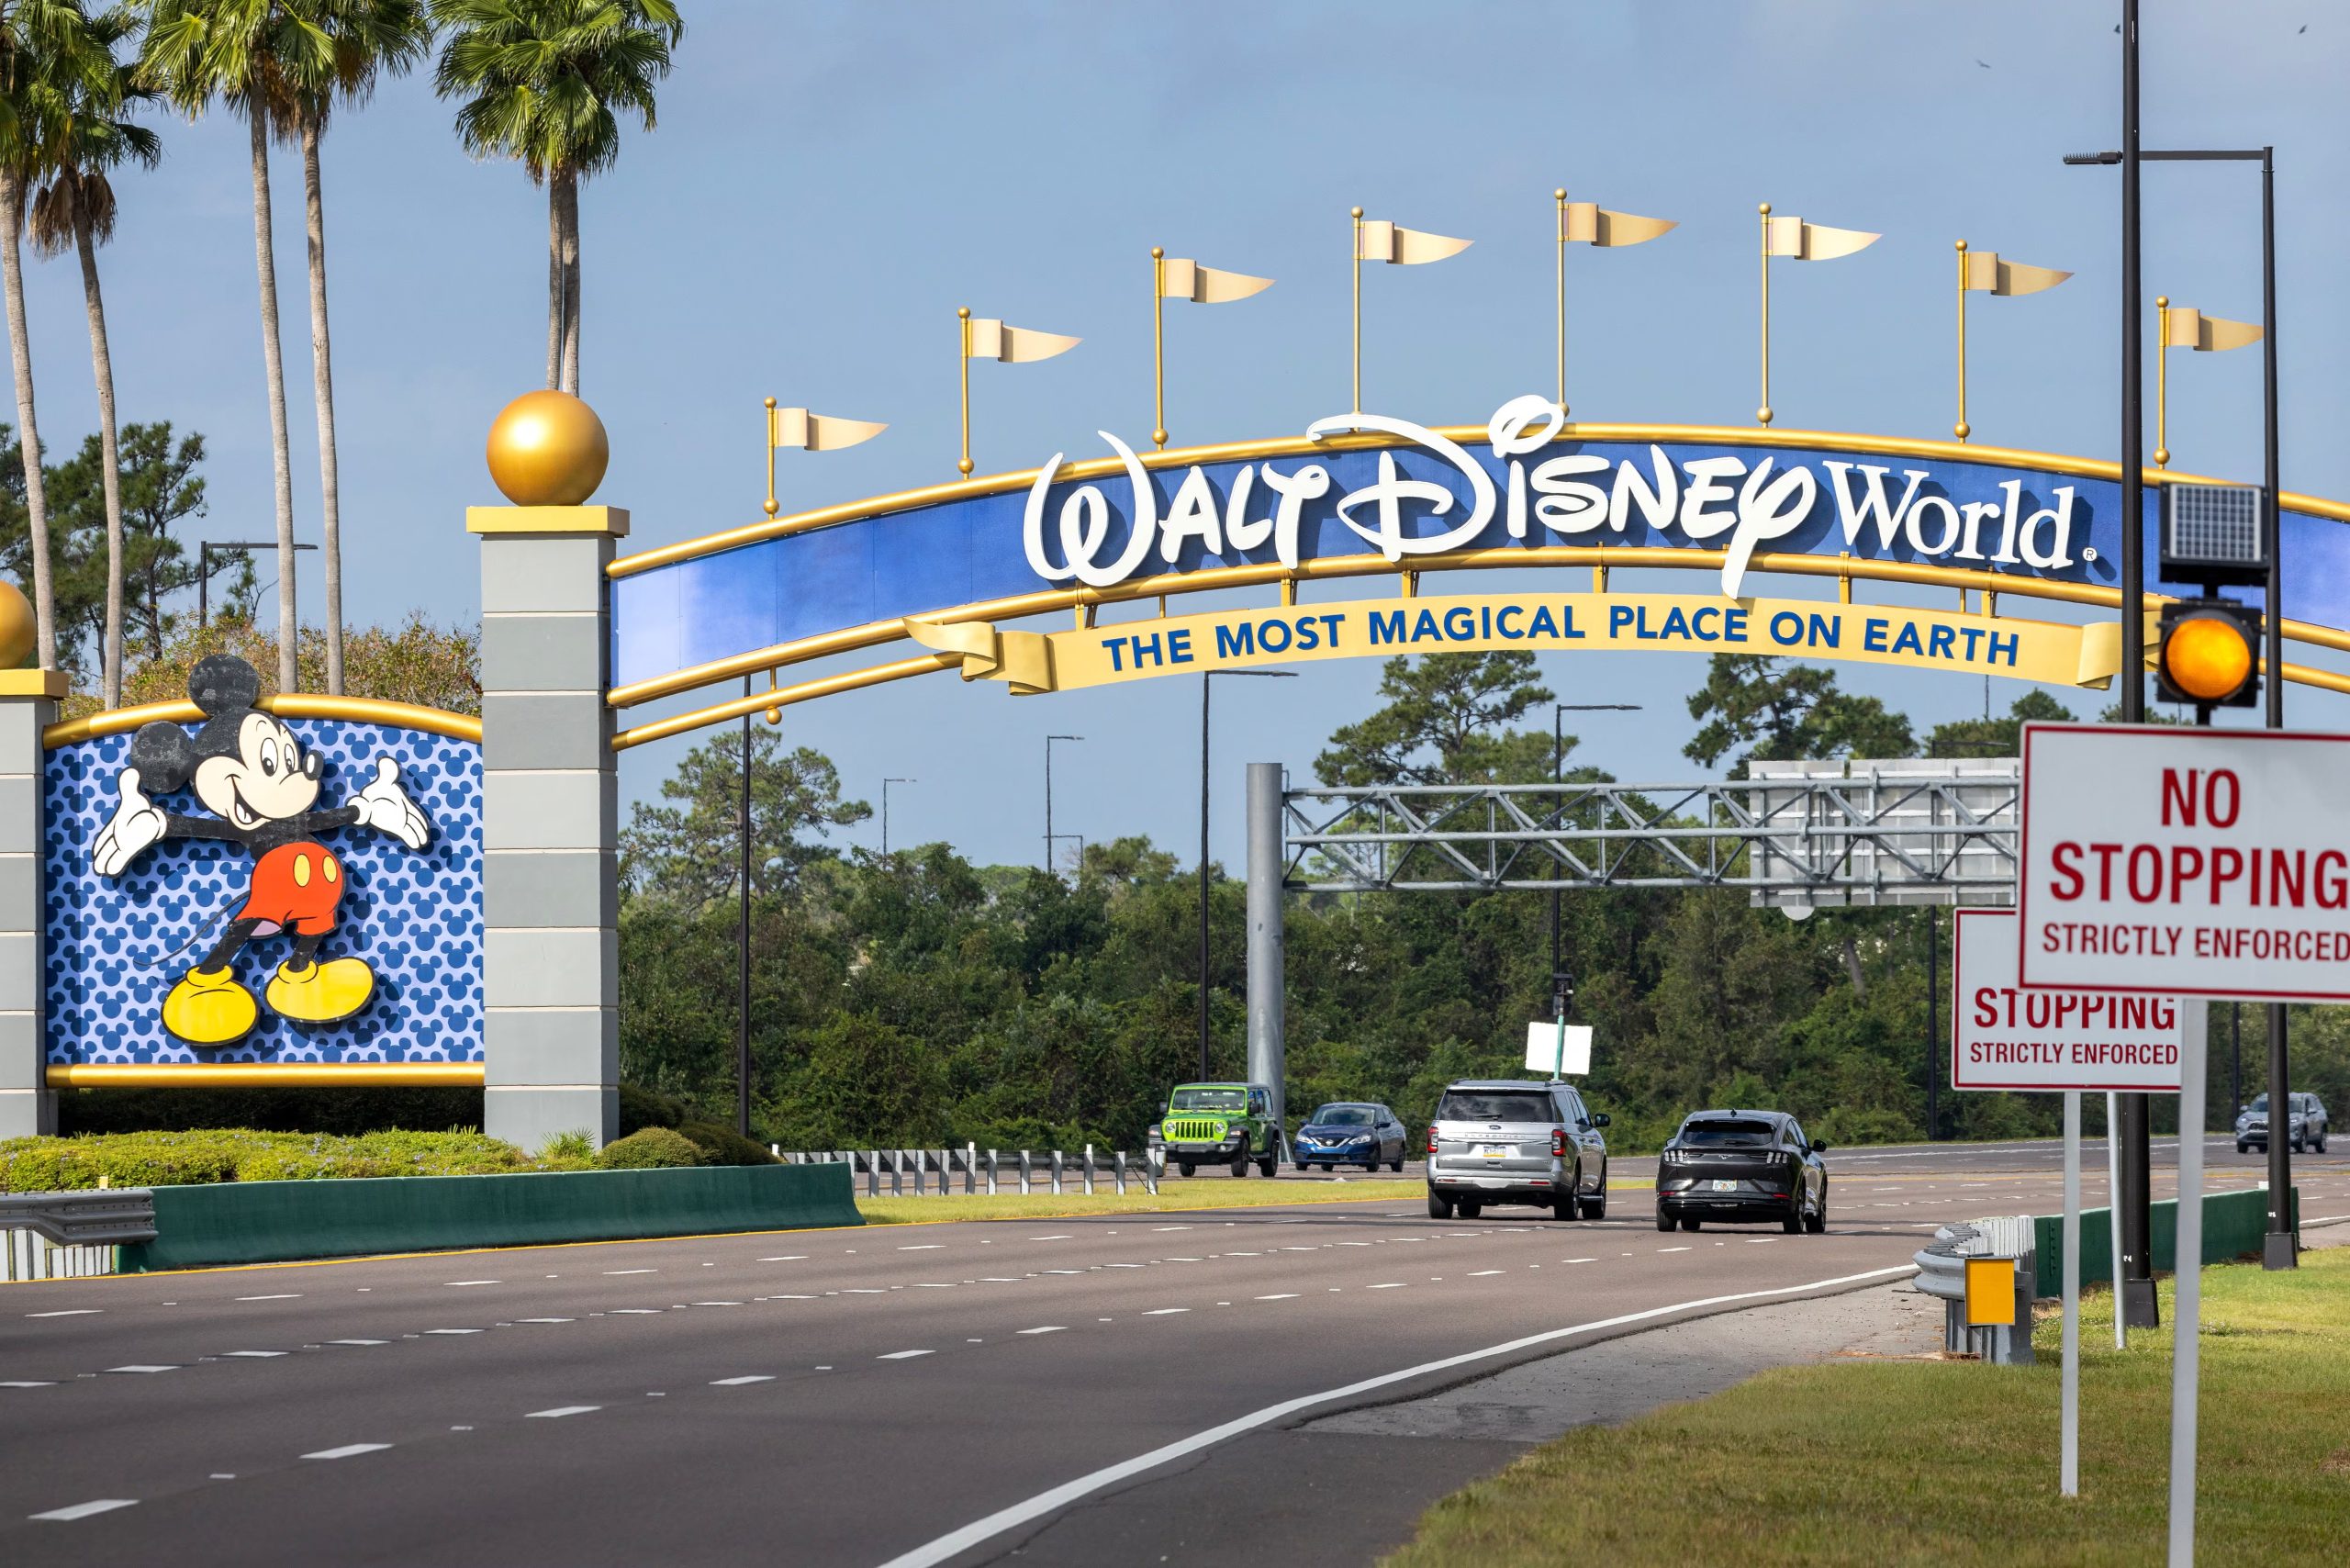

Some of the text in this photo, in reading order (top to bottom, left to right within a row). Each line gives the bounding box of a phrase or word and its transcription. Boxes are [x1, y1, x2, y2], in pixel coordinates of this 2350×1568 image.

[1102, 605, 2019, 671] THE MOST MAGICAL PLACE ON EARTH
[2161, 767, 2241, 829] NO
[2050, 841, 2348, 910] STOPPING
[2042, 923, 2350, 962] STRICTLY ENFORCED
[1974, 987, 2175, 1030] STOPPING
[1970, 1042, 2178, 1065] STRICTLY ENFORCED
